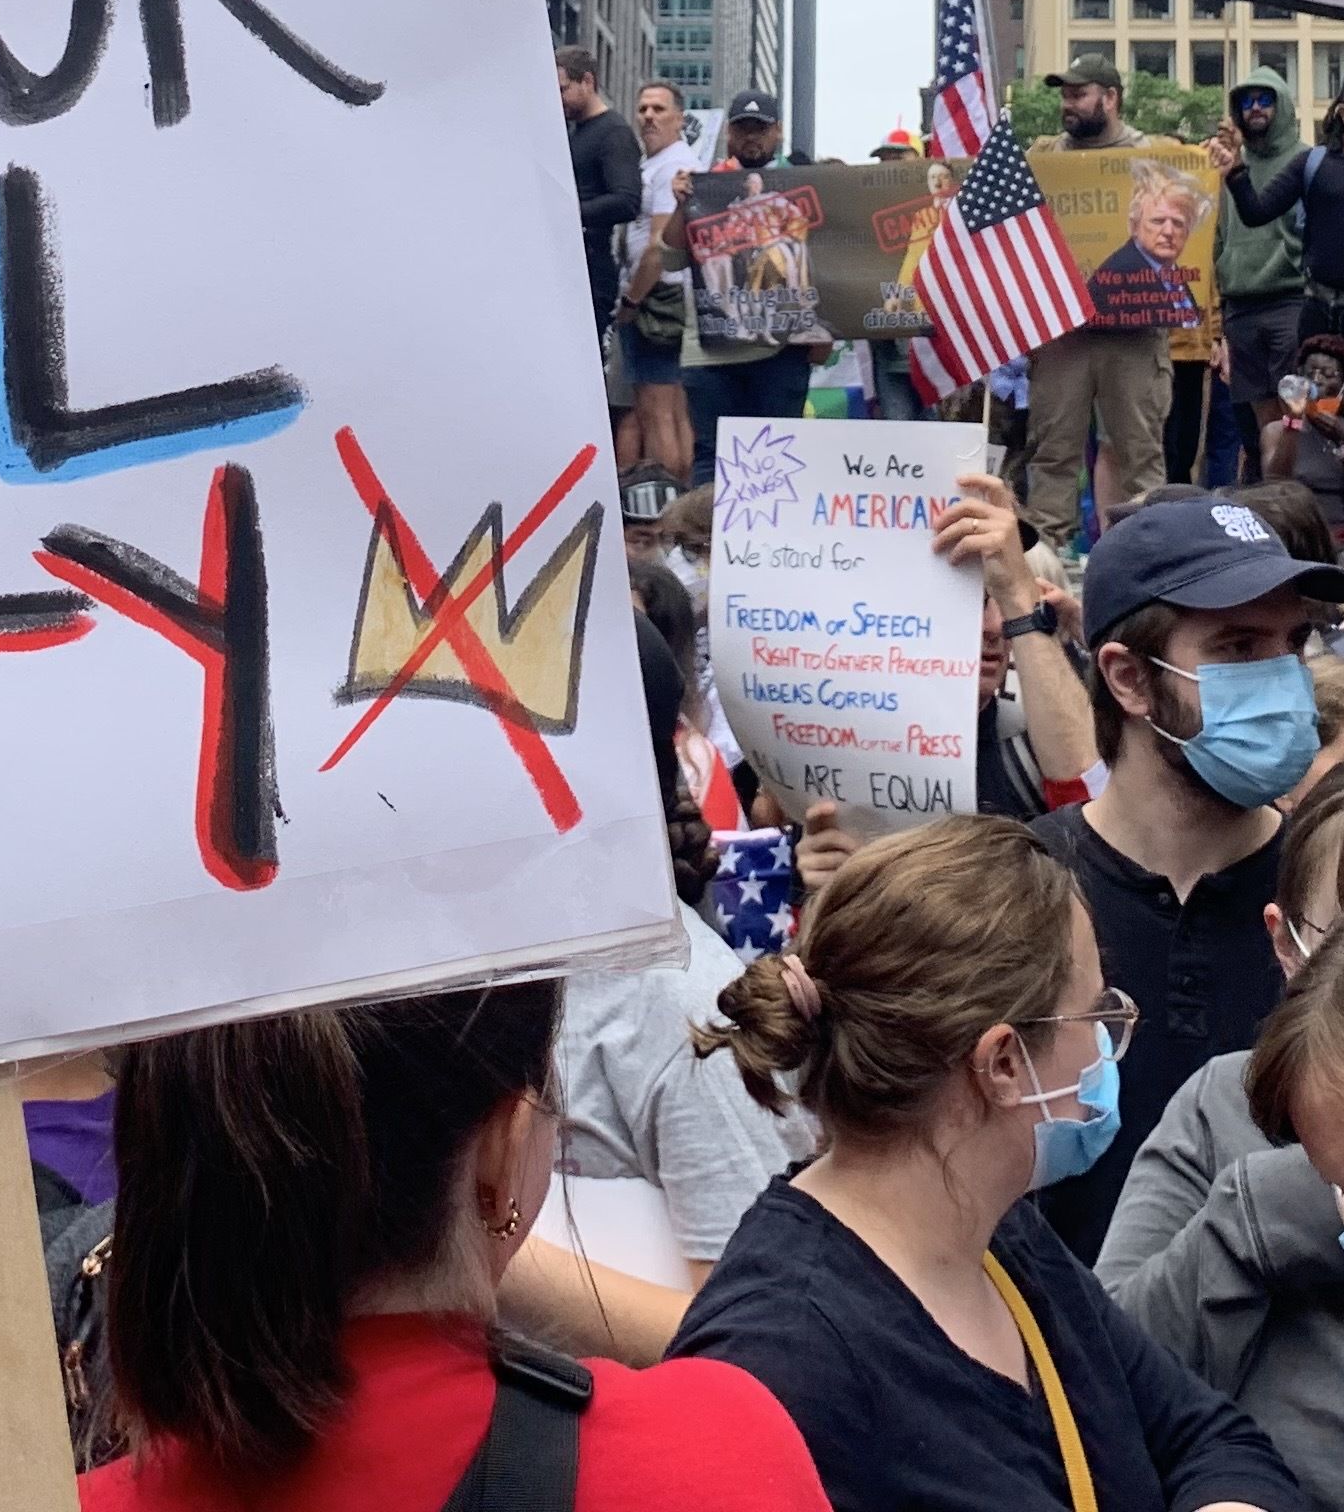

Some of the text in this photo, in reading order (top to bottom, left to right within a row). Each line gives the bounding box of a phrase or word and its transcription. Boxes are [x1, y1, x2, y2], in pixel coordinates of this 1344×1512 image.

[1097, 269, 1122, 286] We
[1126, 268, 1156, 283] will
[1107, 289, 1186, 305] whatever
[768, 310, 818, 332] 1775
[1119, 307, 1153, 325] hell
[740, 455, 776, 480] NO
[843, 453, 924, 479] We Are
[735, 469, 786, 502] KINGS
[723, 540, 866, 572] We stand for
[803, 763, 846, 803] ARE
